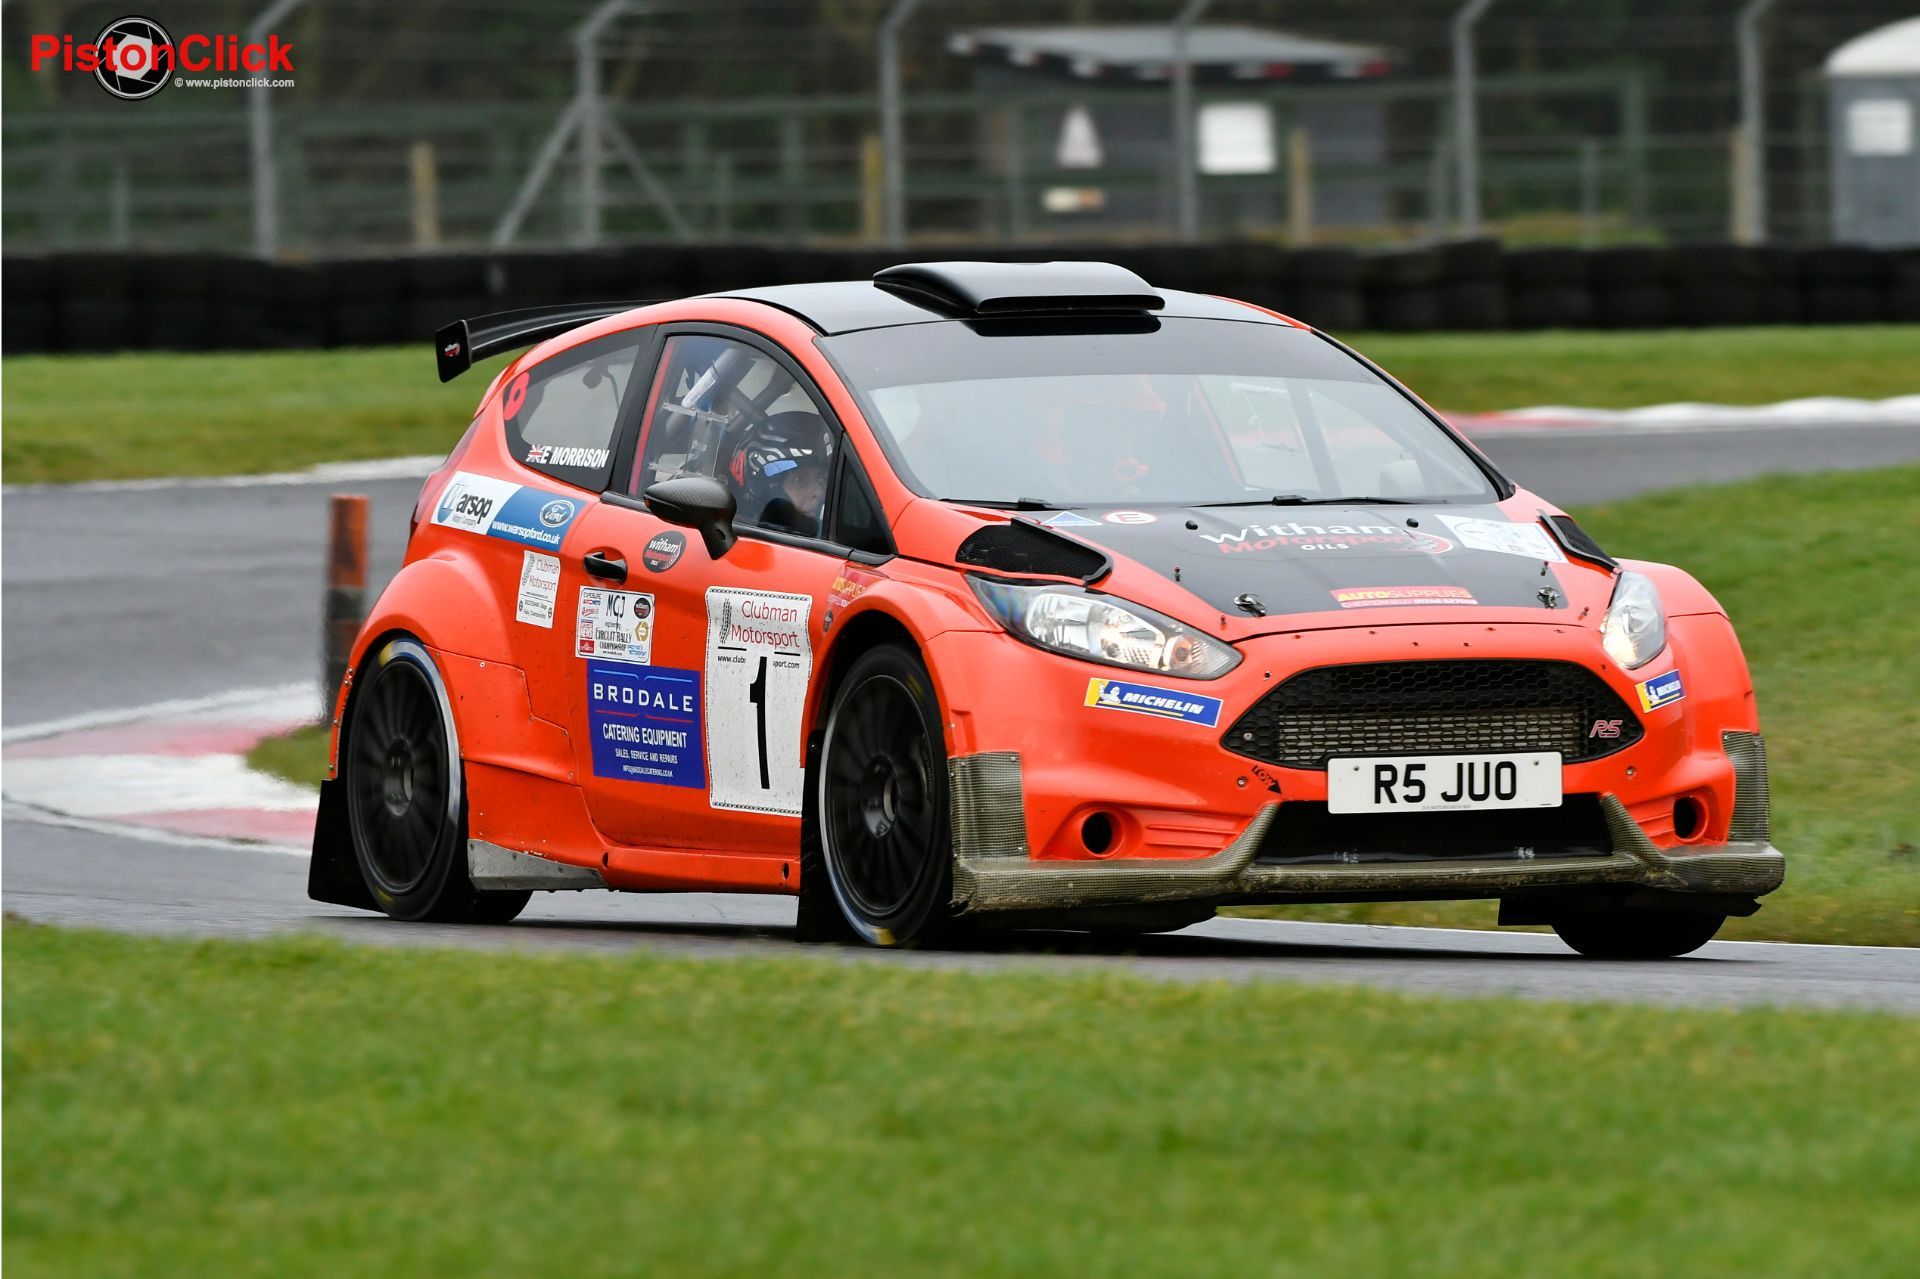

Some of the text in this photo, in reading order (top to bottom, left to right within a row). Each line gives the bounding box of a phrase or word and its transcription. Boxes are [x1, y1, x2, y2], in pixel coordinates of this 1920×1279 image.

[540, 446, 610, 468] E MORRISON
[491, 520, 561, 545] www.warsopford.co.uk
[649, 538, 679, 553] witham
[1300, 543, 1350, 551] OILS
[536, 559, 559, 575] Clubman
[528, 575, 557, 591] Motorsport
[741, 600, 798, 623] Clubman
[616, 631, 632, 643] RALLY
[731, 624, 800, 649] Motorsport
[593, 683, 694, 713] BRODALE
[1122, 692, 1205, 714] MICHELIN
[750, 656, 771, 790] 1
[1589, 720, 1623, 738] RS
[602, 723, 688, 749] CATERING EQUIPMENT
[615, 748, 678, 765] SALES, SERVICE AND REPAIRS
[1251, 764, 1277, 785] TOW
[1374, 761, 1517, 804] R5 JUO
